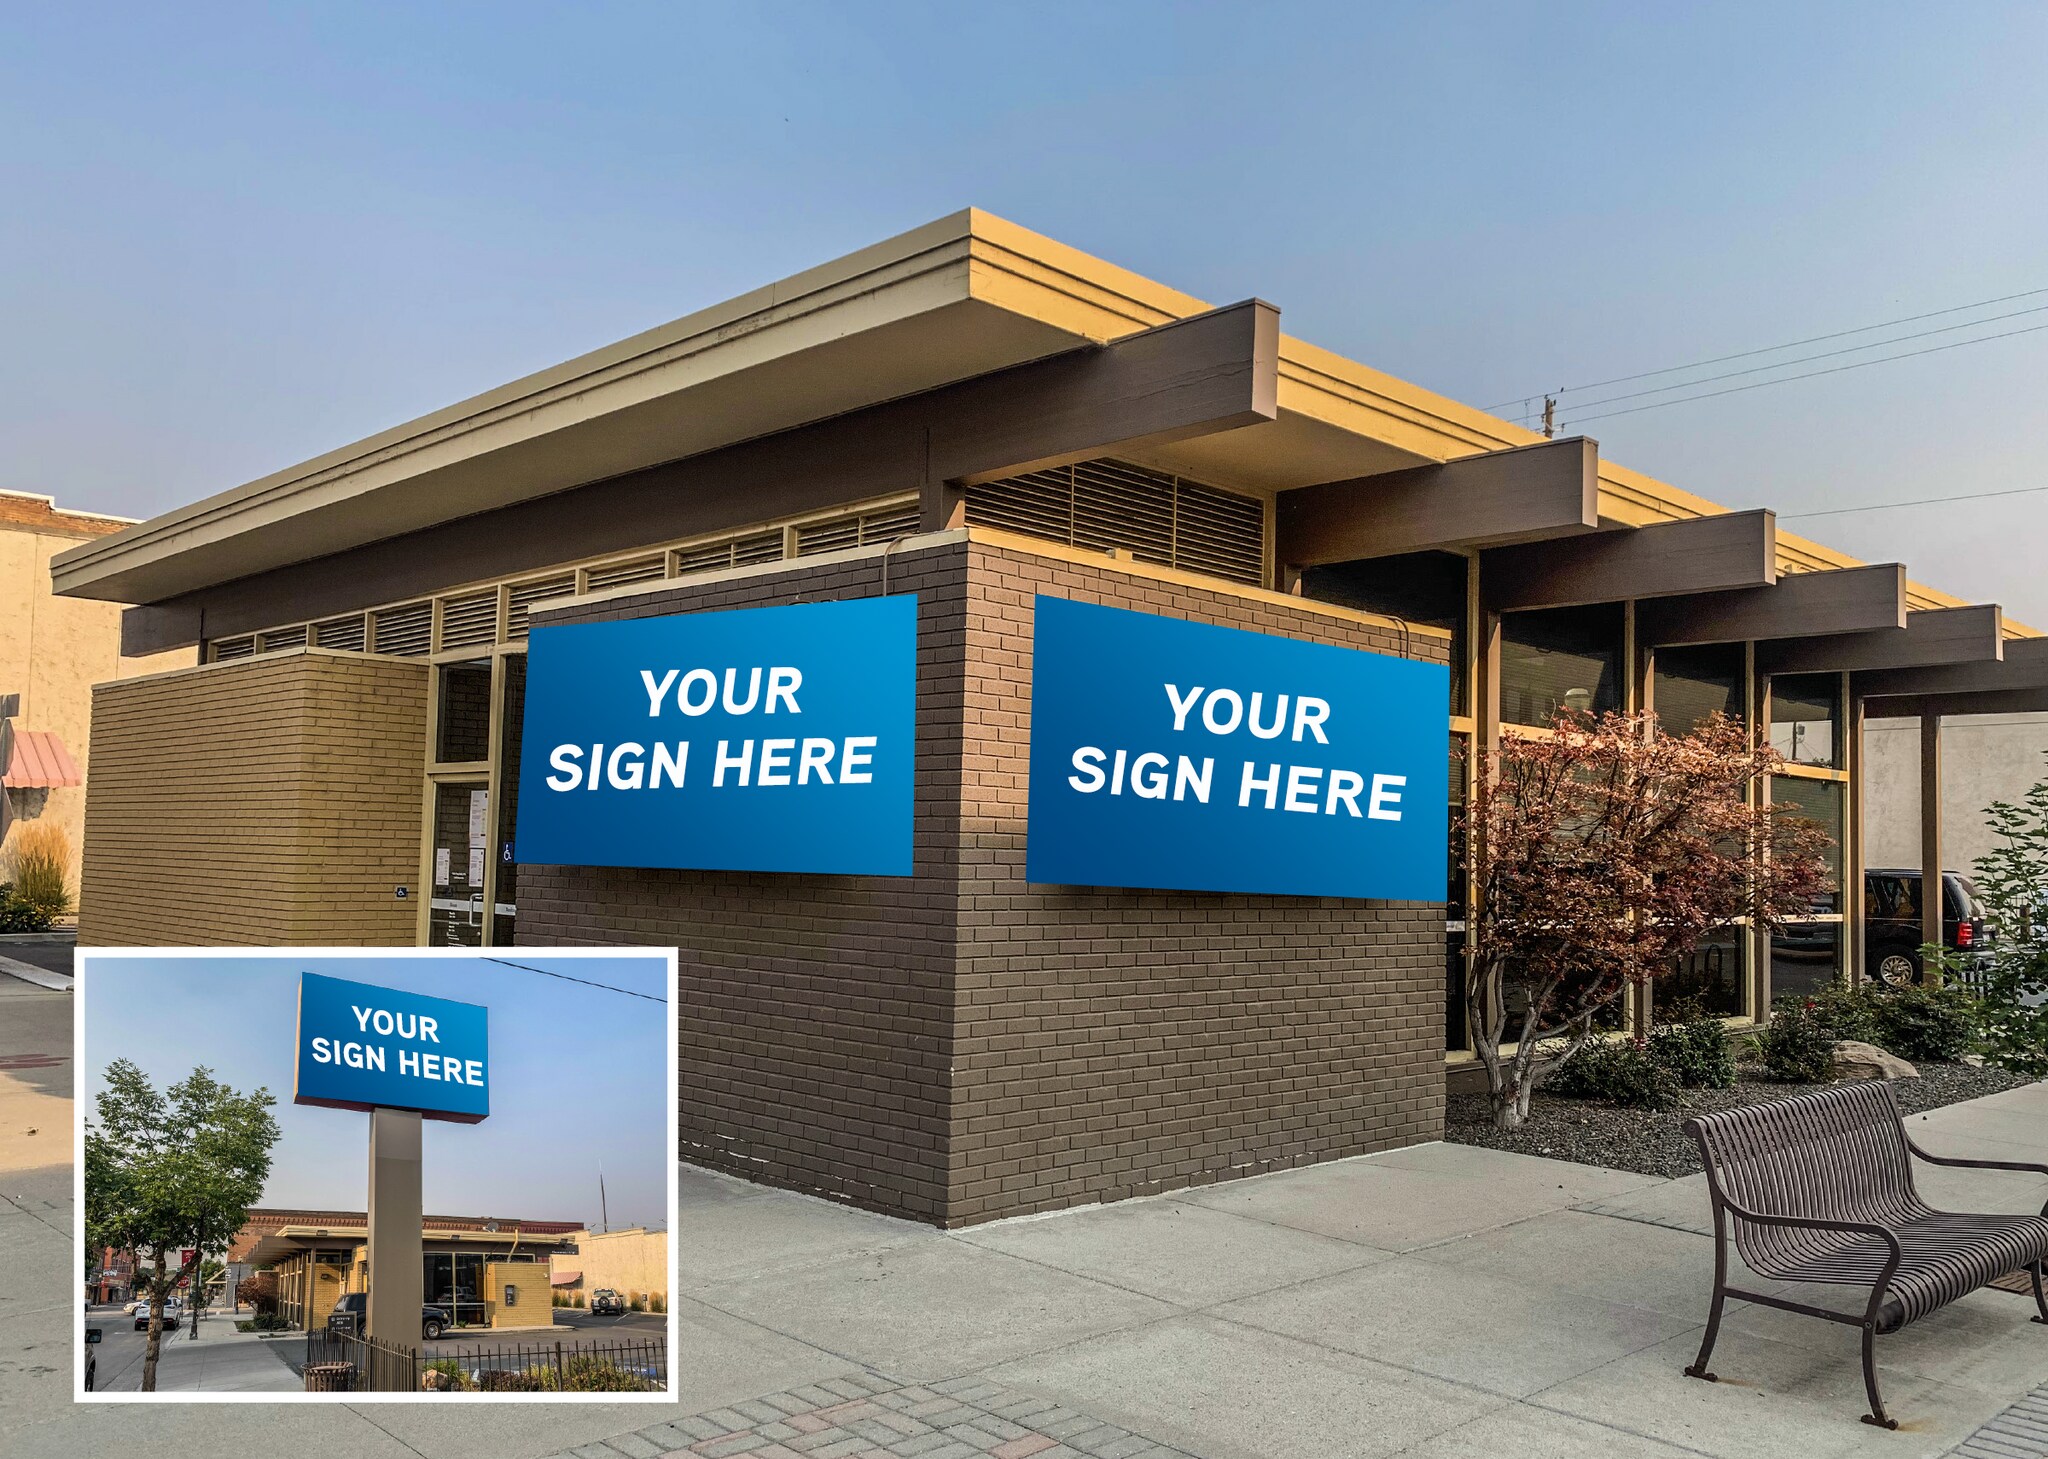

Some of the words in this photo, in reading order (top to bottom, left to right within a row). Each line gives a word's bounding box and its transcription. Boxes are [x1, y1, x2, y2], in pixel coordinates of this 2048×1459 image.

[640, 667, 802, 716] YOUR
[1165, 684, 1330, 744] YOUR
[546, 739, 689, 791] SIGN
[713, 736, 877, 787] HERE
[1069, 747, 1214, 803] SIGN
[1239, 762, 1406, 821] HERE
[351, 1005, 440, 1043] YOUR
[311, 1037, 386, 1072] SIGN
[398, 1049, 484, 1087] HERE
